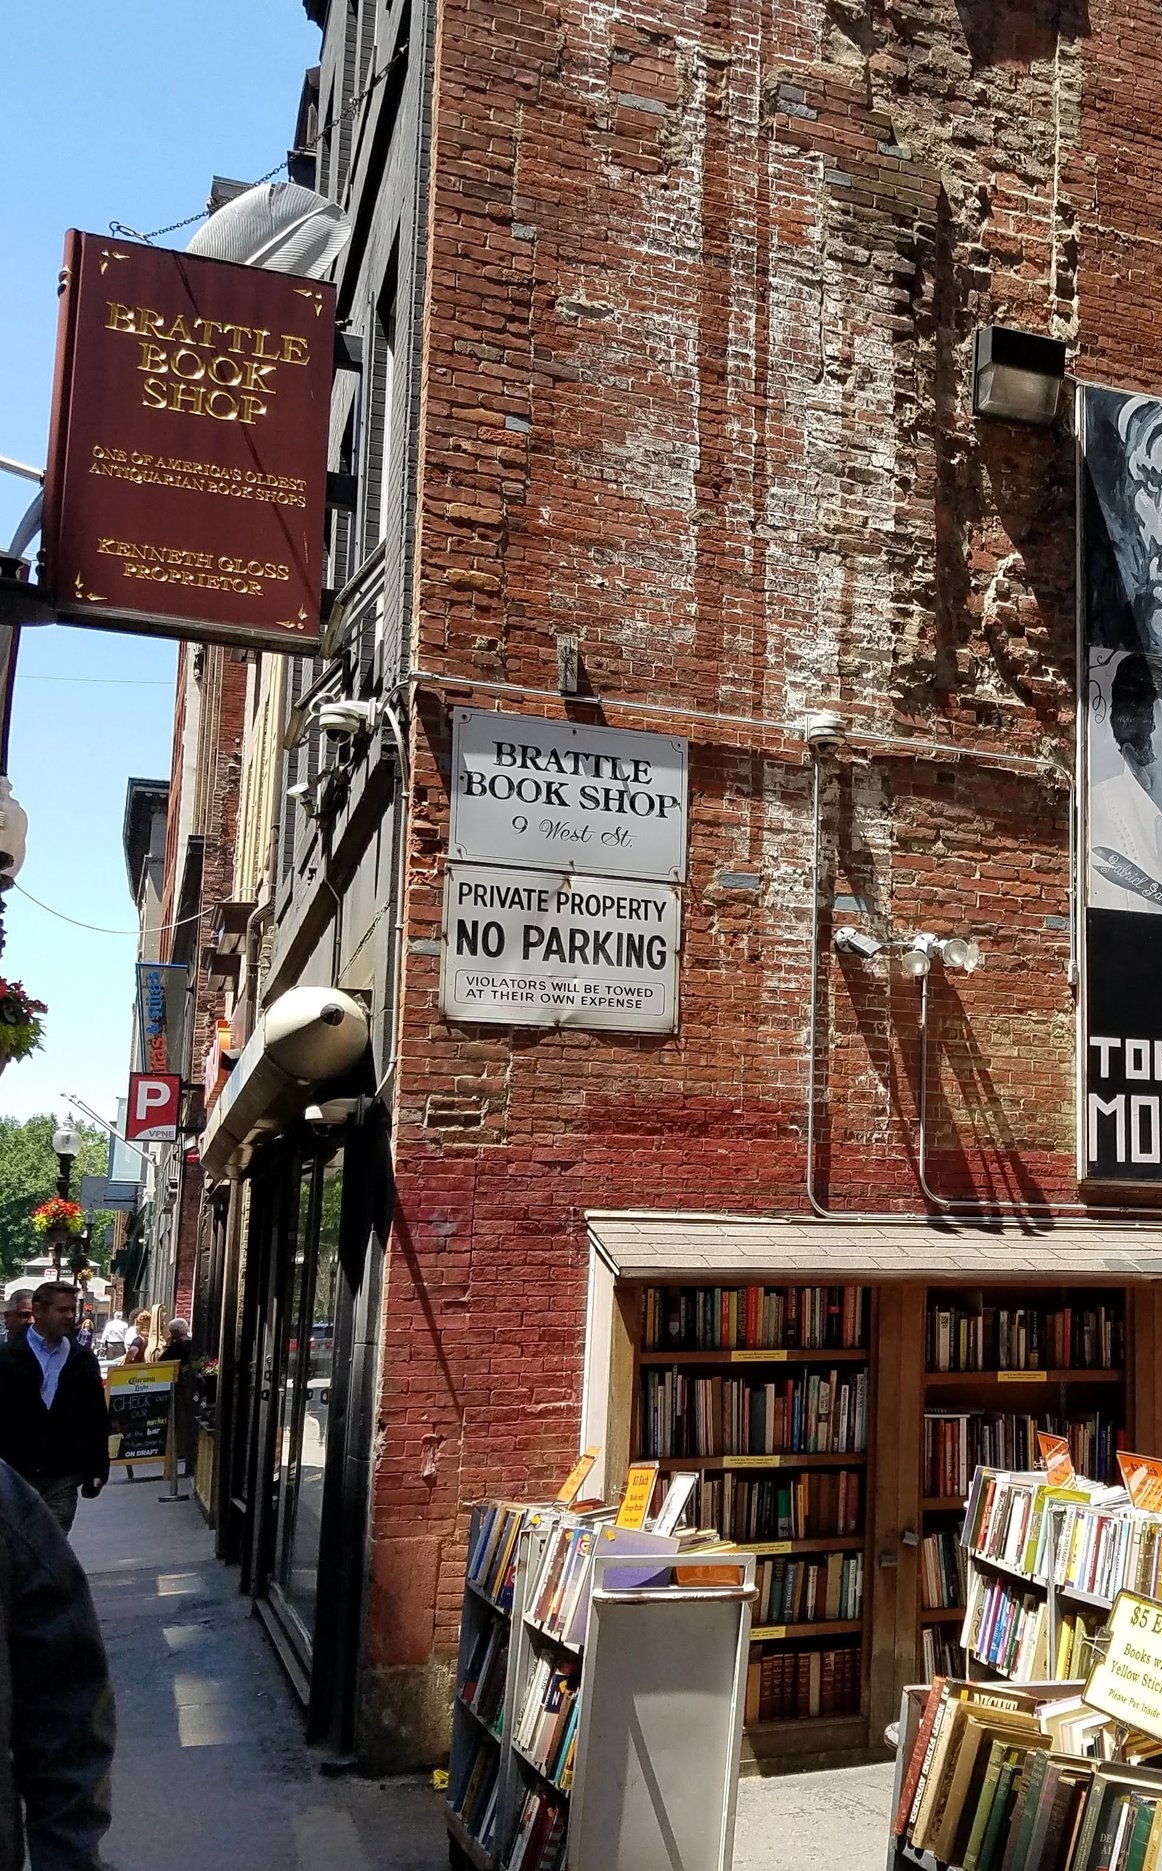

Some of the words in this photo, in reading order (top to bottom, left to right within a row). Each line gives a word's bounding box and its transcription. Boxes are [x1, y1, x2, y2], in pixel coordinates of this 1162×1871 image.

[104, 301, 311, 366] BRATTLE
[137, 341, 277, 395] BOOK
[142, 378, 268, 425] SHOP
[88, 461, 205, 492] ANTIQUARIAN
[207, 477, 254, 501] BOOK
[255, 485, 307, 509] SHOPS
[92, 445, 126, 466] ONE
[129, 450, 153, 468] OF
[154, 453, 242, 483] AMERICA'S
[245, 469, 308, 492] OLDEST
[96, 537, 213, 570] KENNETH
[218, 556, 290, 582] GLOSS
[122, 562, 265, 598] PROPRIETOR
[492, 741, 653, 785] BRATTLE
[462, 770, 571, 808] BOOK
[579, 785, 679, 819] SHOP
[512, 815, 529, 834] 9
[539, 818, 596, 844] West
[600, 825, 638, 849] St.
[458, 882, 549, 913] PRIVATE
[556, 891, 667, 923] PROPERTY
[456, 919, 505, 959] NO
[522, 924, 668, 971] PARKING
[465, 976, 547, 991] VIOLATORS
[551, 981, 580, 994] WILL
[584, 983, 600, 995] BE
[605, 985, 654, 999] TOWED
[465, 988, 485, 1000] AT
[491, 989, 535, 1003] THEIR
[540, 992, 576, 1005] OWN
[580, 995, 643, 1010] EXPENSE
[136, 1081, 171, 1120] P
[149, 1130, 175, 1139] VPNE
[136, 1448, 159, 1457] DRAFT
[1130, 1602, 1151, 1629] $5
[1110, 1659, 1140, 1682] Yellow
[1123, 1642, 1151, 1665] Books
[1108, 1688, 1128, 1704] Please
[1128, 1697, 1140, 1710] Pay
[1141, 1704, 1161, 1719] Inside
